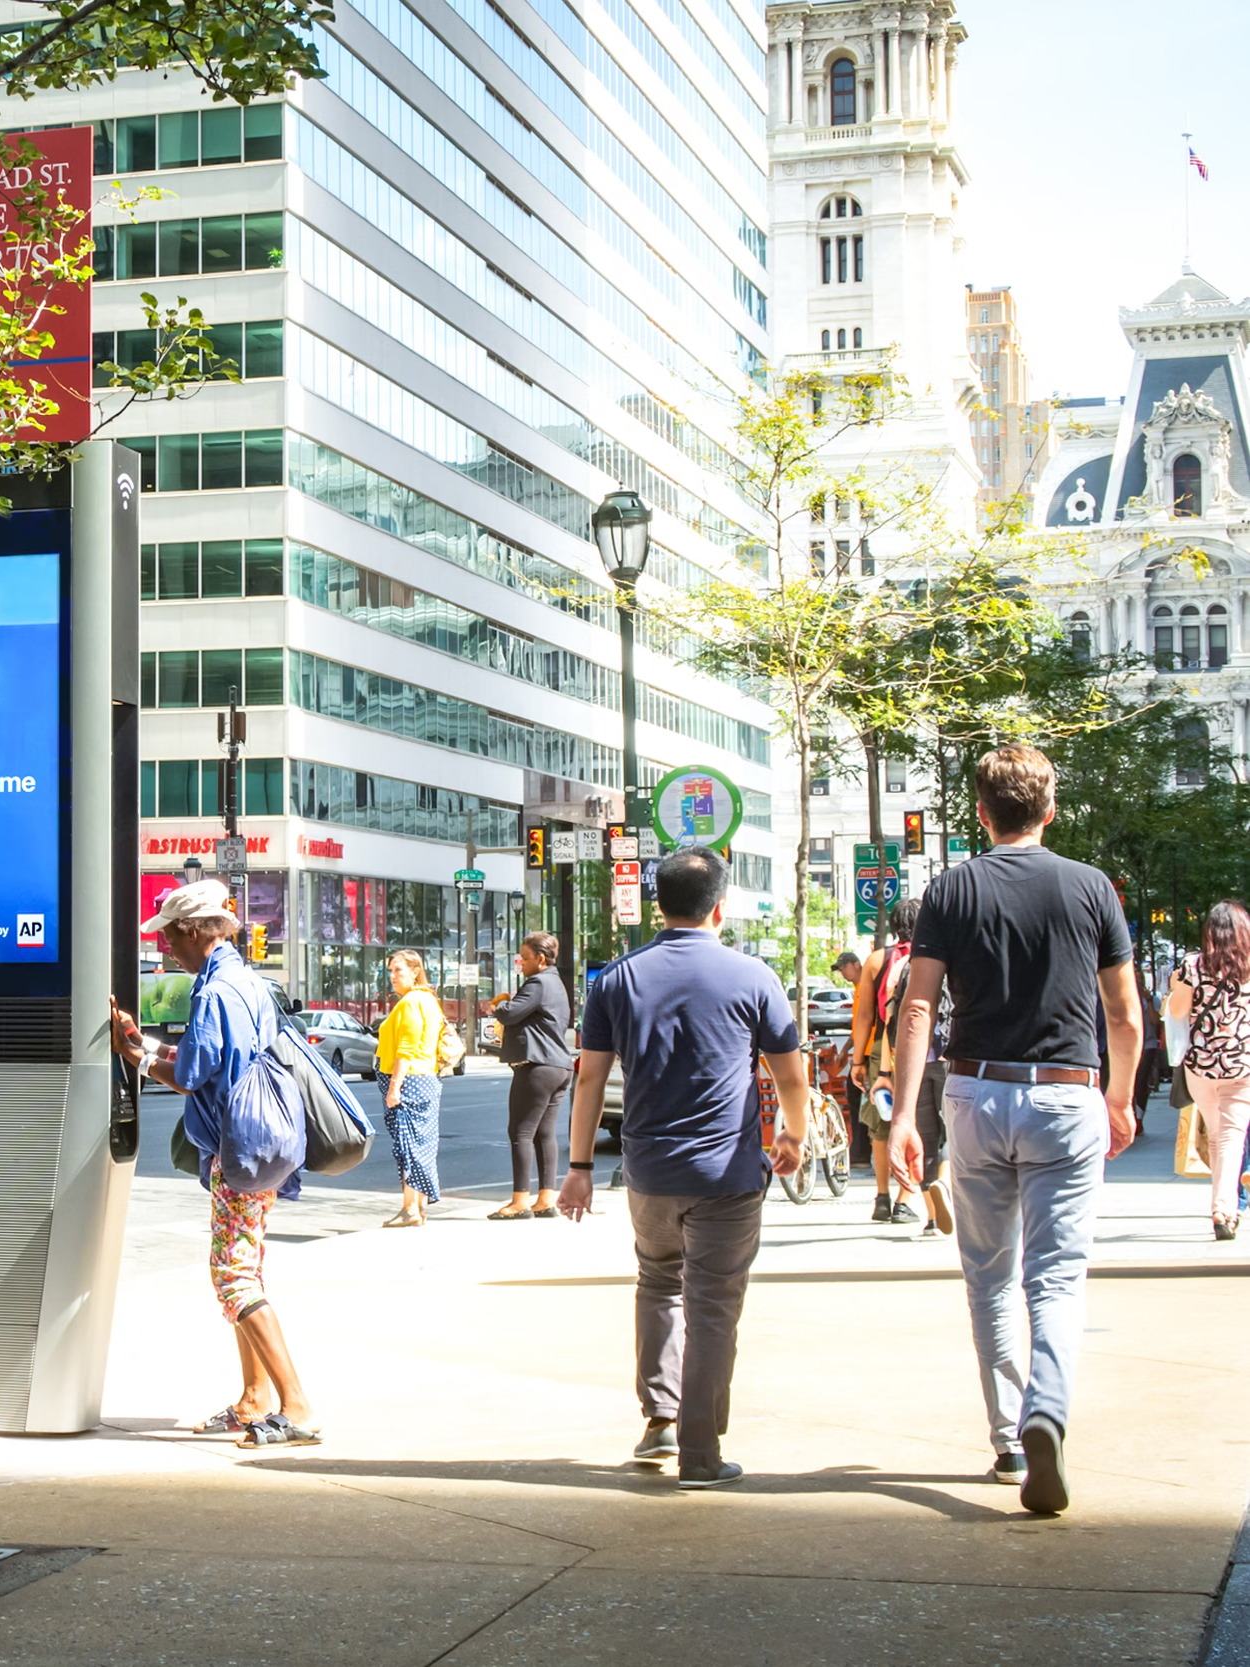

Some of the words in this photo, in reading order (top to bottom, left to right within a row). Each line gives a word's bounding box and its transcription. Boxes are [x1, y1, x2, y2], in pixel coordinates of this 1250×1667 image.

[39, 162, 72, 185] ST.
[641, 873, 656, 884] EAG
[19, 922, 43, 937] AP
